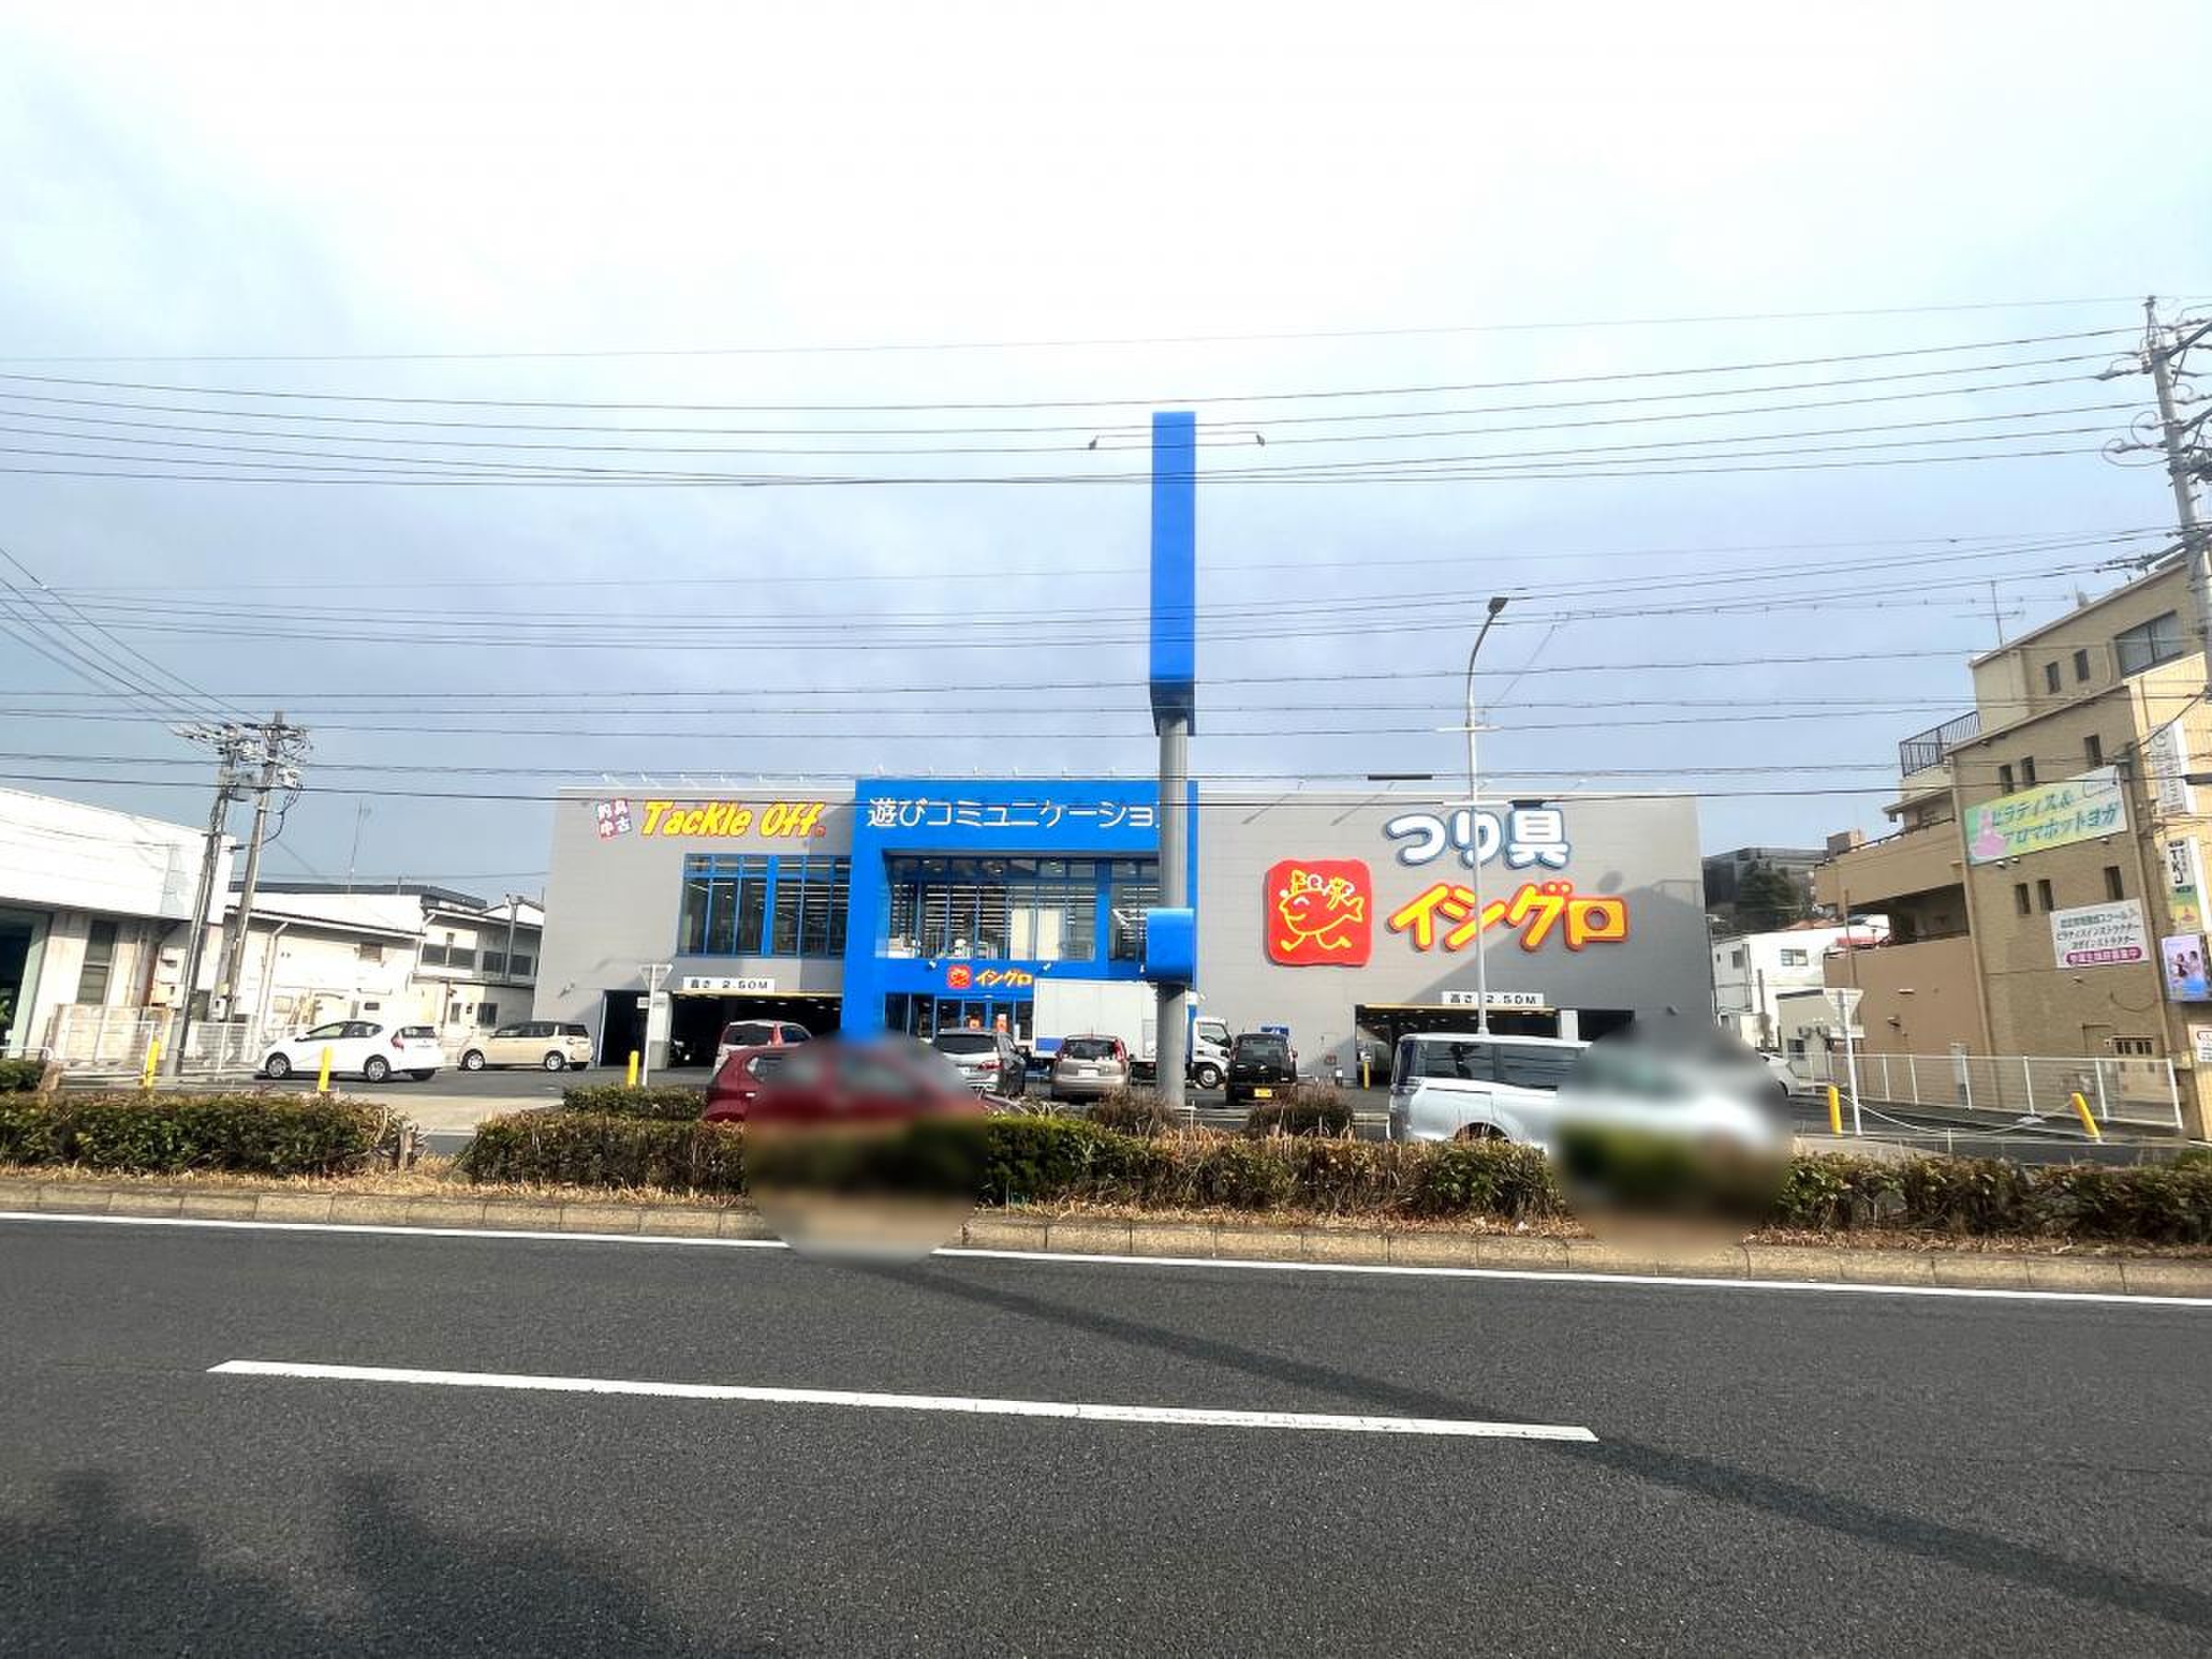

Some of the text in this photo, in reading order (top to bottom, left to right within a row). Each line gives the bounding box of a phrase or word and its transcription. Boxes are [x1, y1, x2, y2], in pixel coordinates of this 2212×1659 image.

[759, 801, 826, 838] Off
[866, 797, 1160, 829] 遊びコミュニケーショ
[1385, 807, 1571, 870] つり具
[1386, 881, 1630, 952] イシグロ
[975, 970, 1032, 987] イシグロ
